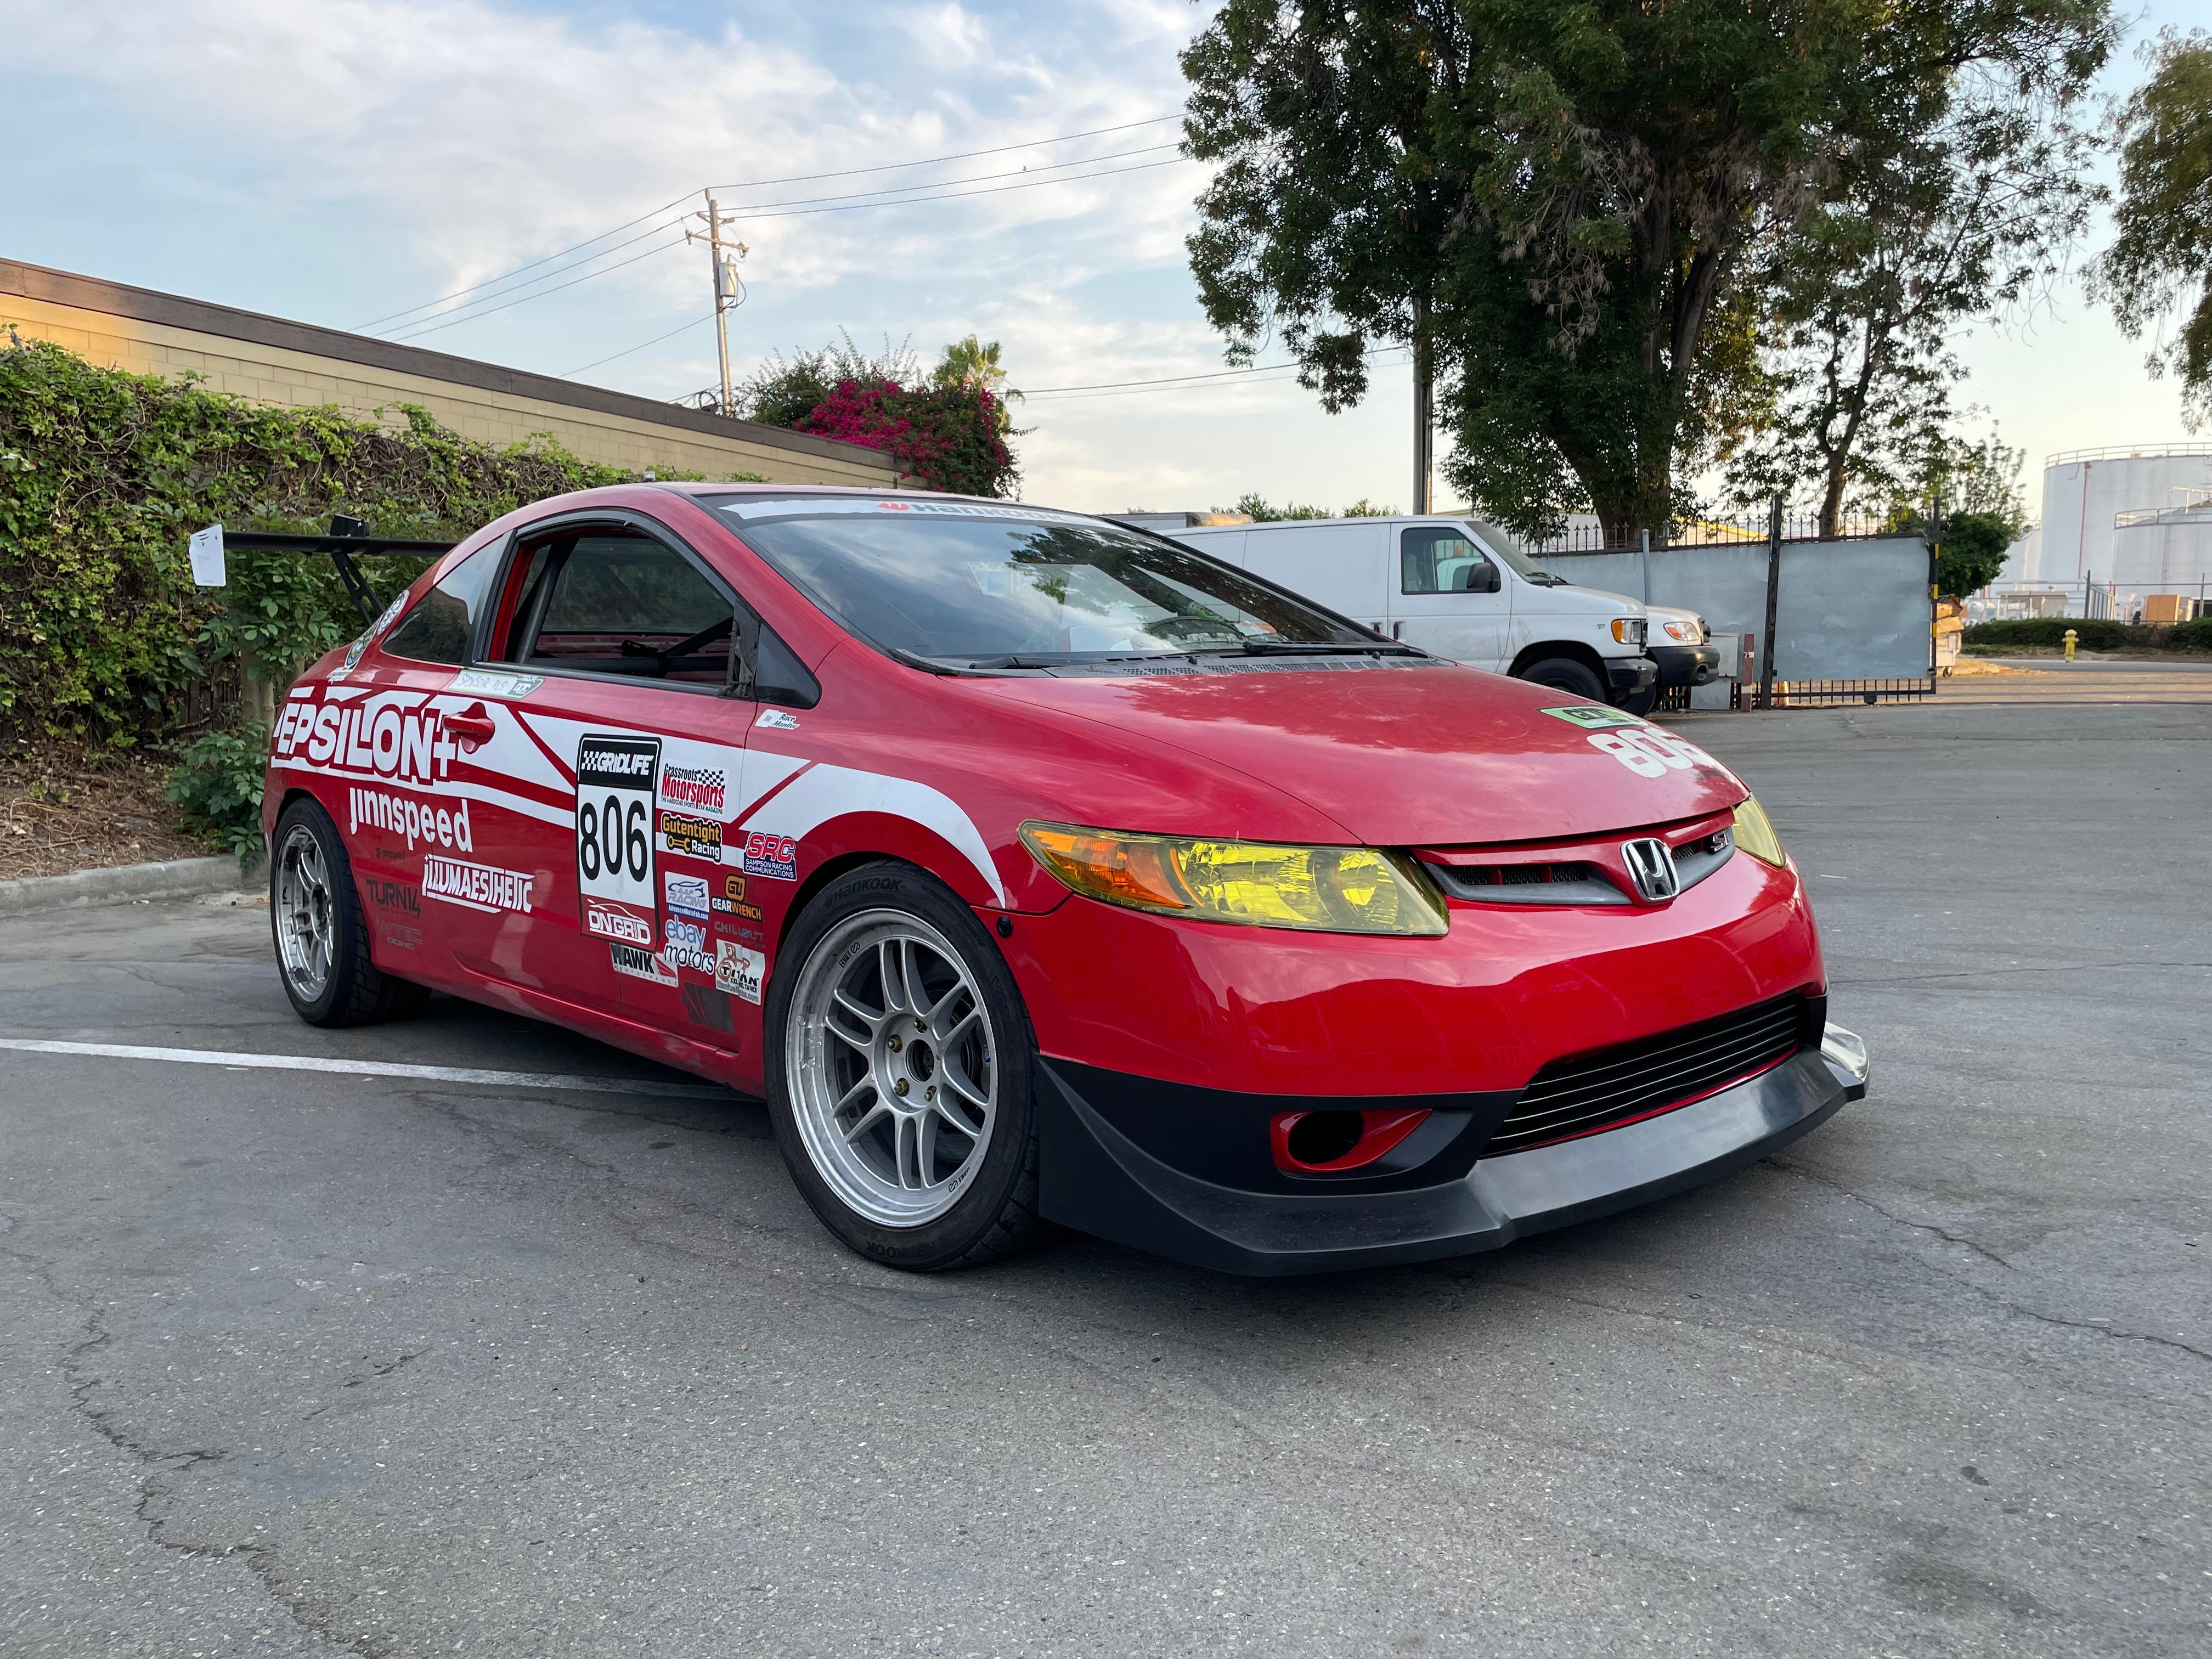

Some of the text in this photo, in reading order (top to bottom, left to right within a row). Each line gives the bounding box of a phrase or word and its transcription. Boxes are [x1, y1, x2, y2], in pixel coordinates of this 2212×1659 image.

[457, 673, 490, 689] SPONSOR
[772, 720, 799, 729] Monitor
[779, 714, 795, 722] Race
[597, 752, 654, 776] GRIDLIFE
[664, 763, 698, 782] Grassroots
[661, 774, 725, 809] Motorsports
[706, 806, 723, 815] MAGAZINE
[580, 795, 648, 882] 806
[662, 815, 720, 842] Gutentight
[691, 839, 720, 860] Racing
[746, 833, 795, 864] SRC
[744, 866, 794, 878] COMMUNICATIONS
[746, 858, 793, 872] SAMPSON RACING
[667, 892, 708, 909] RACING
[712, 897, 762, 921] GEARWRENCH
[666, 915, 706, 950] ebay
[611, 943, 655, 974] HAWK
[664, 945, 715, 974] motors
[614, 965, 678, 986] PERFORMANCE
[730, 977, 739, 986] XXL
